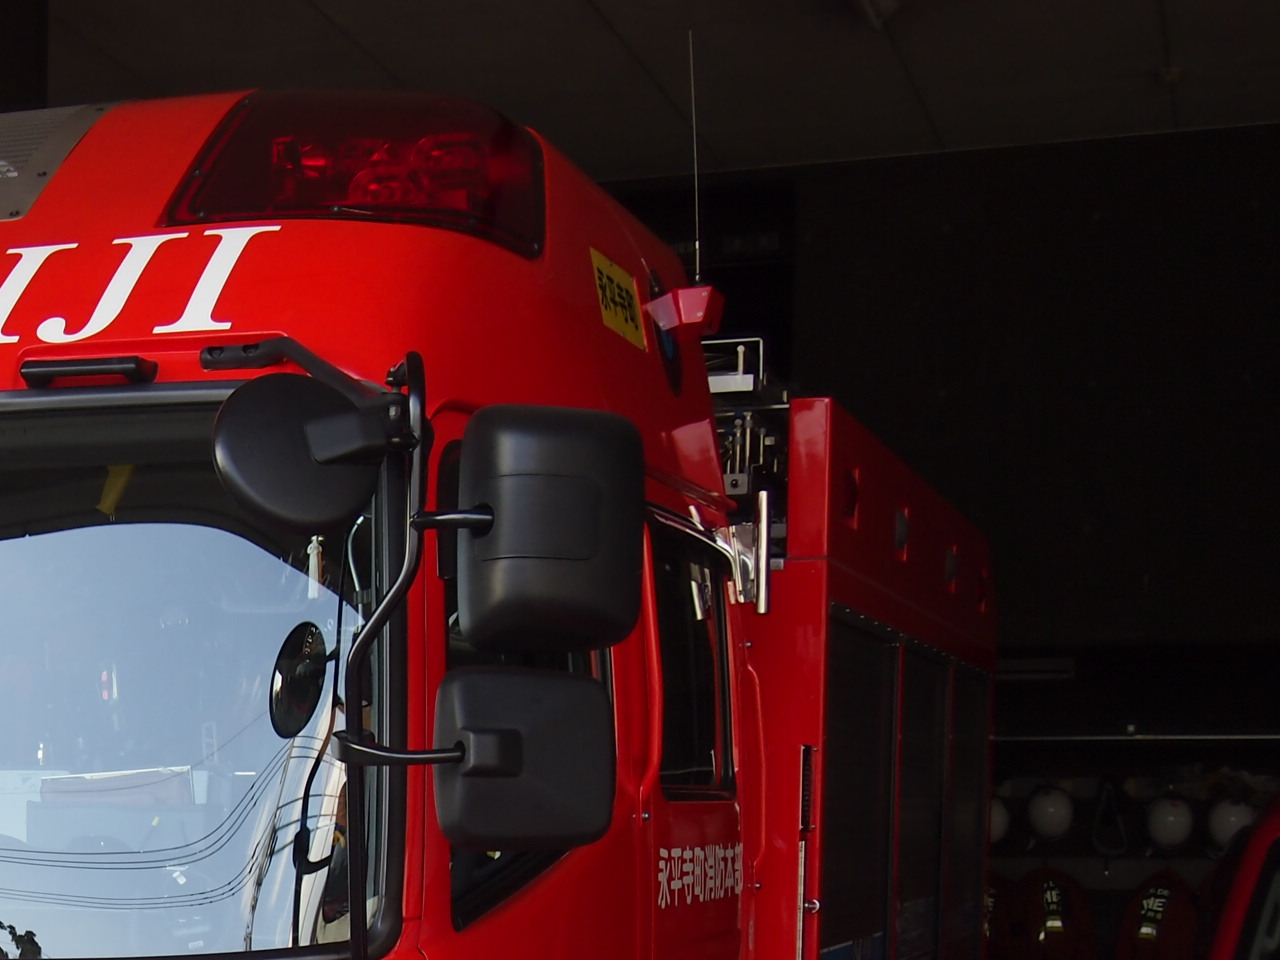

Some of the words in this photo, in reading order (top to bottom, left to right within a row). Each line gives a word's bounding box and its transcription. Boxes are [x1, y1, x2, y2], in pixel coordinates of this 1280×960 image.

[596, 266, 639, 331] 永平寺町
[657, 841, 744, 910] 永平寺町消防本部
